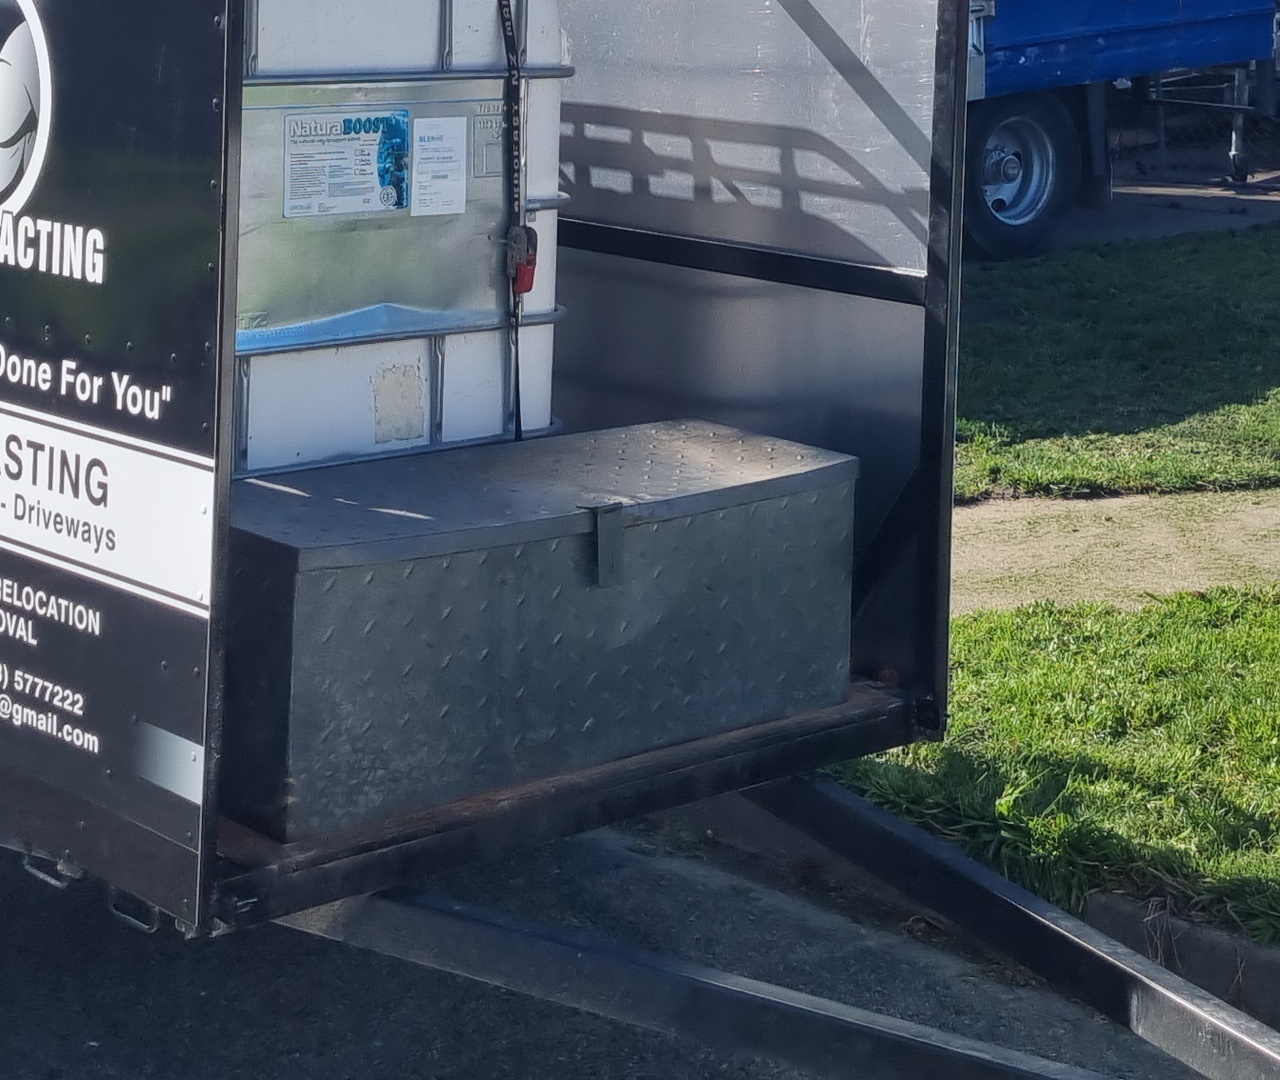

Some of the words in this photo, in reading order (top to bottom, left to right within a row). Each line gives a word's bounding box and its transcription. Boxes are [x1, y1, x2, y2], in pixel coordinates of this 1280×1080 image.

[60, 360, 102, 405] For
[112, 375, 171, 420] You"
[14, 493, 116, 554] Driveways
[14, 671, 84, 716] 5777222
